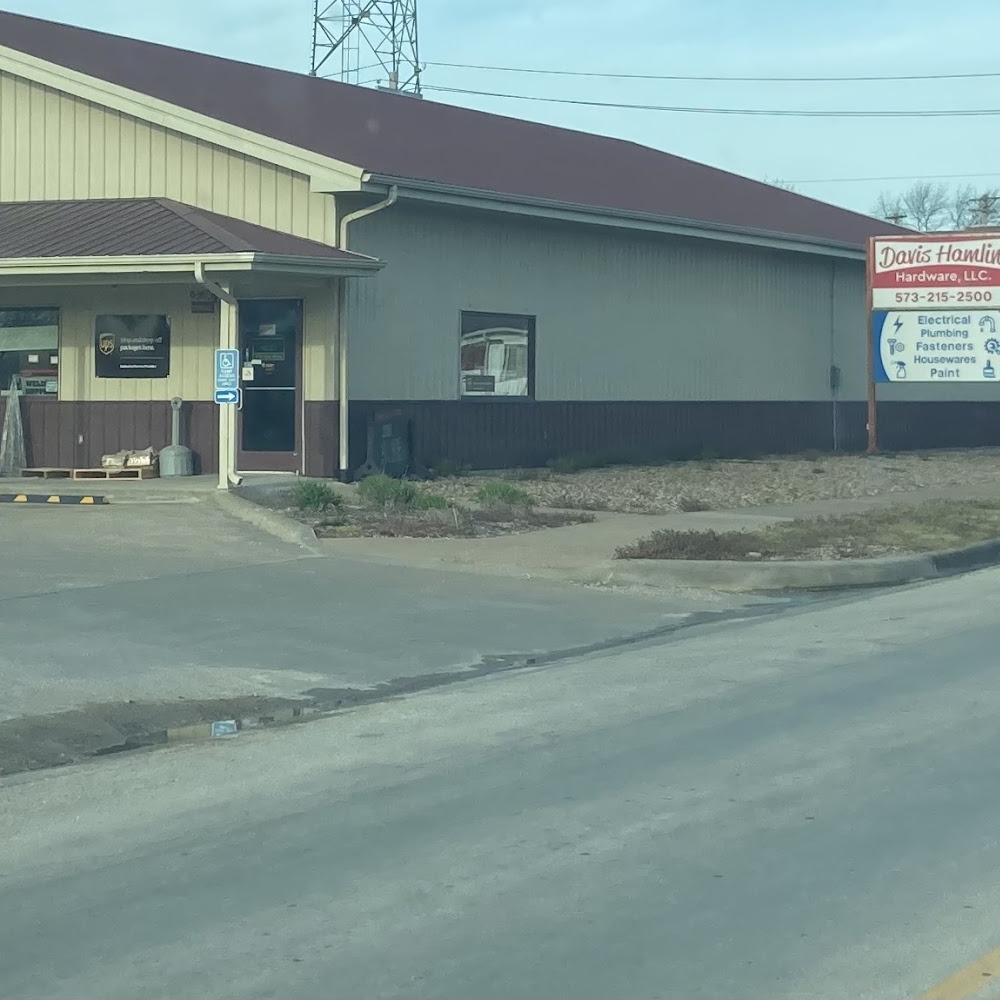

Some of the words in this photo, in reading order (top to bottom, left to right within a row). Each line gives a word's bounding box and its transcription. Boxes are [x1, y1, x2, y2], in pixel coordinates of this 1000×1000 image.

[879, 245, 932, 268] Davis
[936, 243, 1000, 265] Hamlin
[896, 271, 961, 283] Hardware,
[964, 270, 992, 281] LLC.
[895, 291, 992, 303] 573-215-2500
[917, 315, 971, 325] Electrical
[920, 329, 969, 339] Plumbing
[916, 342, 974, 351] Fasteners
[913, 355, 976, 364] Housewares
[930, 368, 960, 378] Paint
